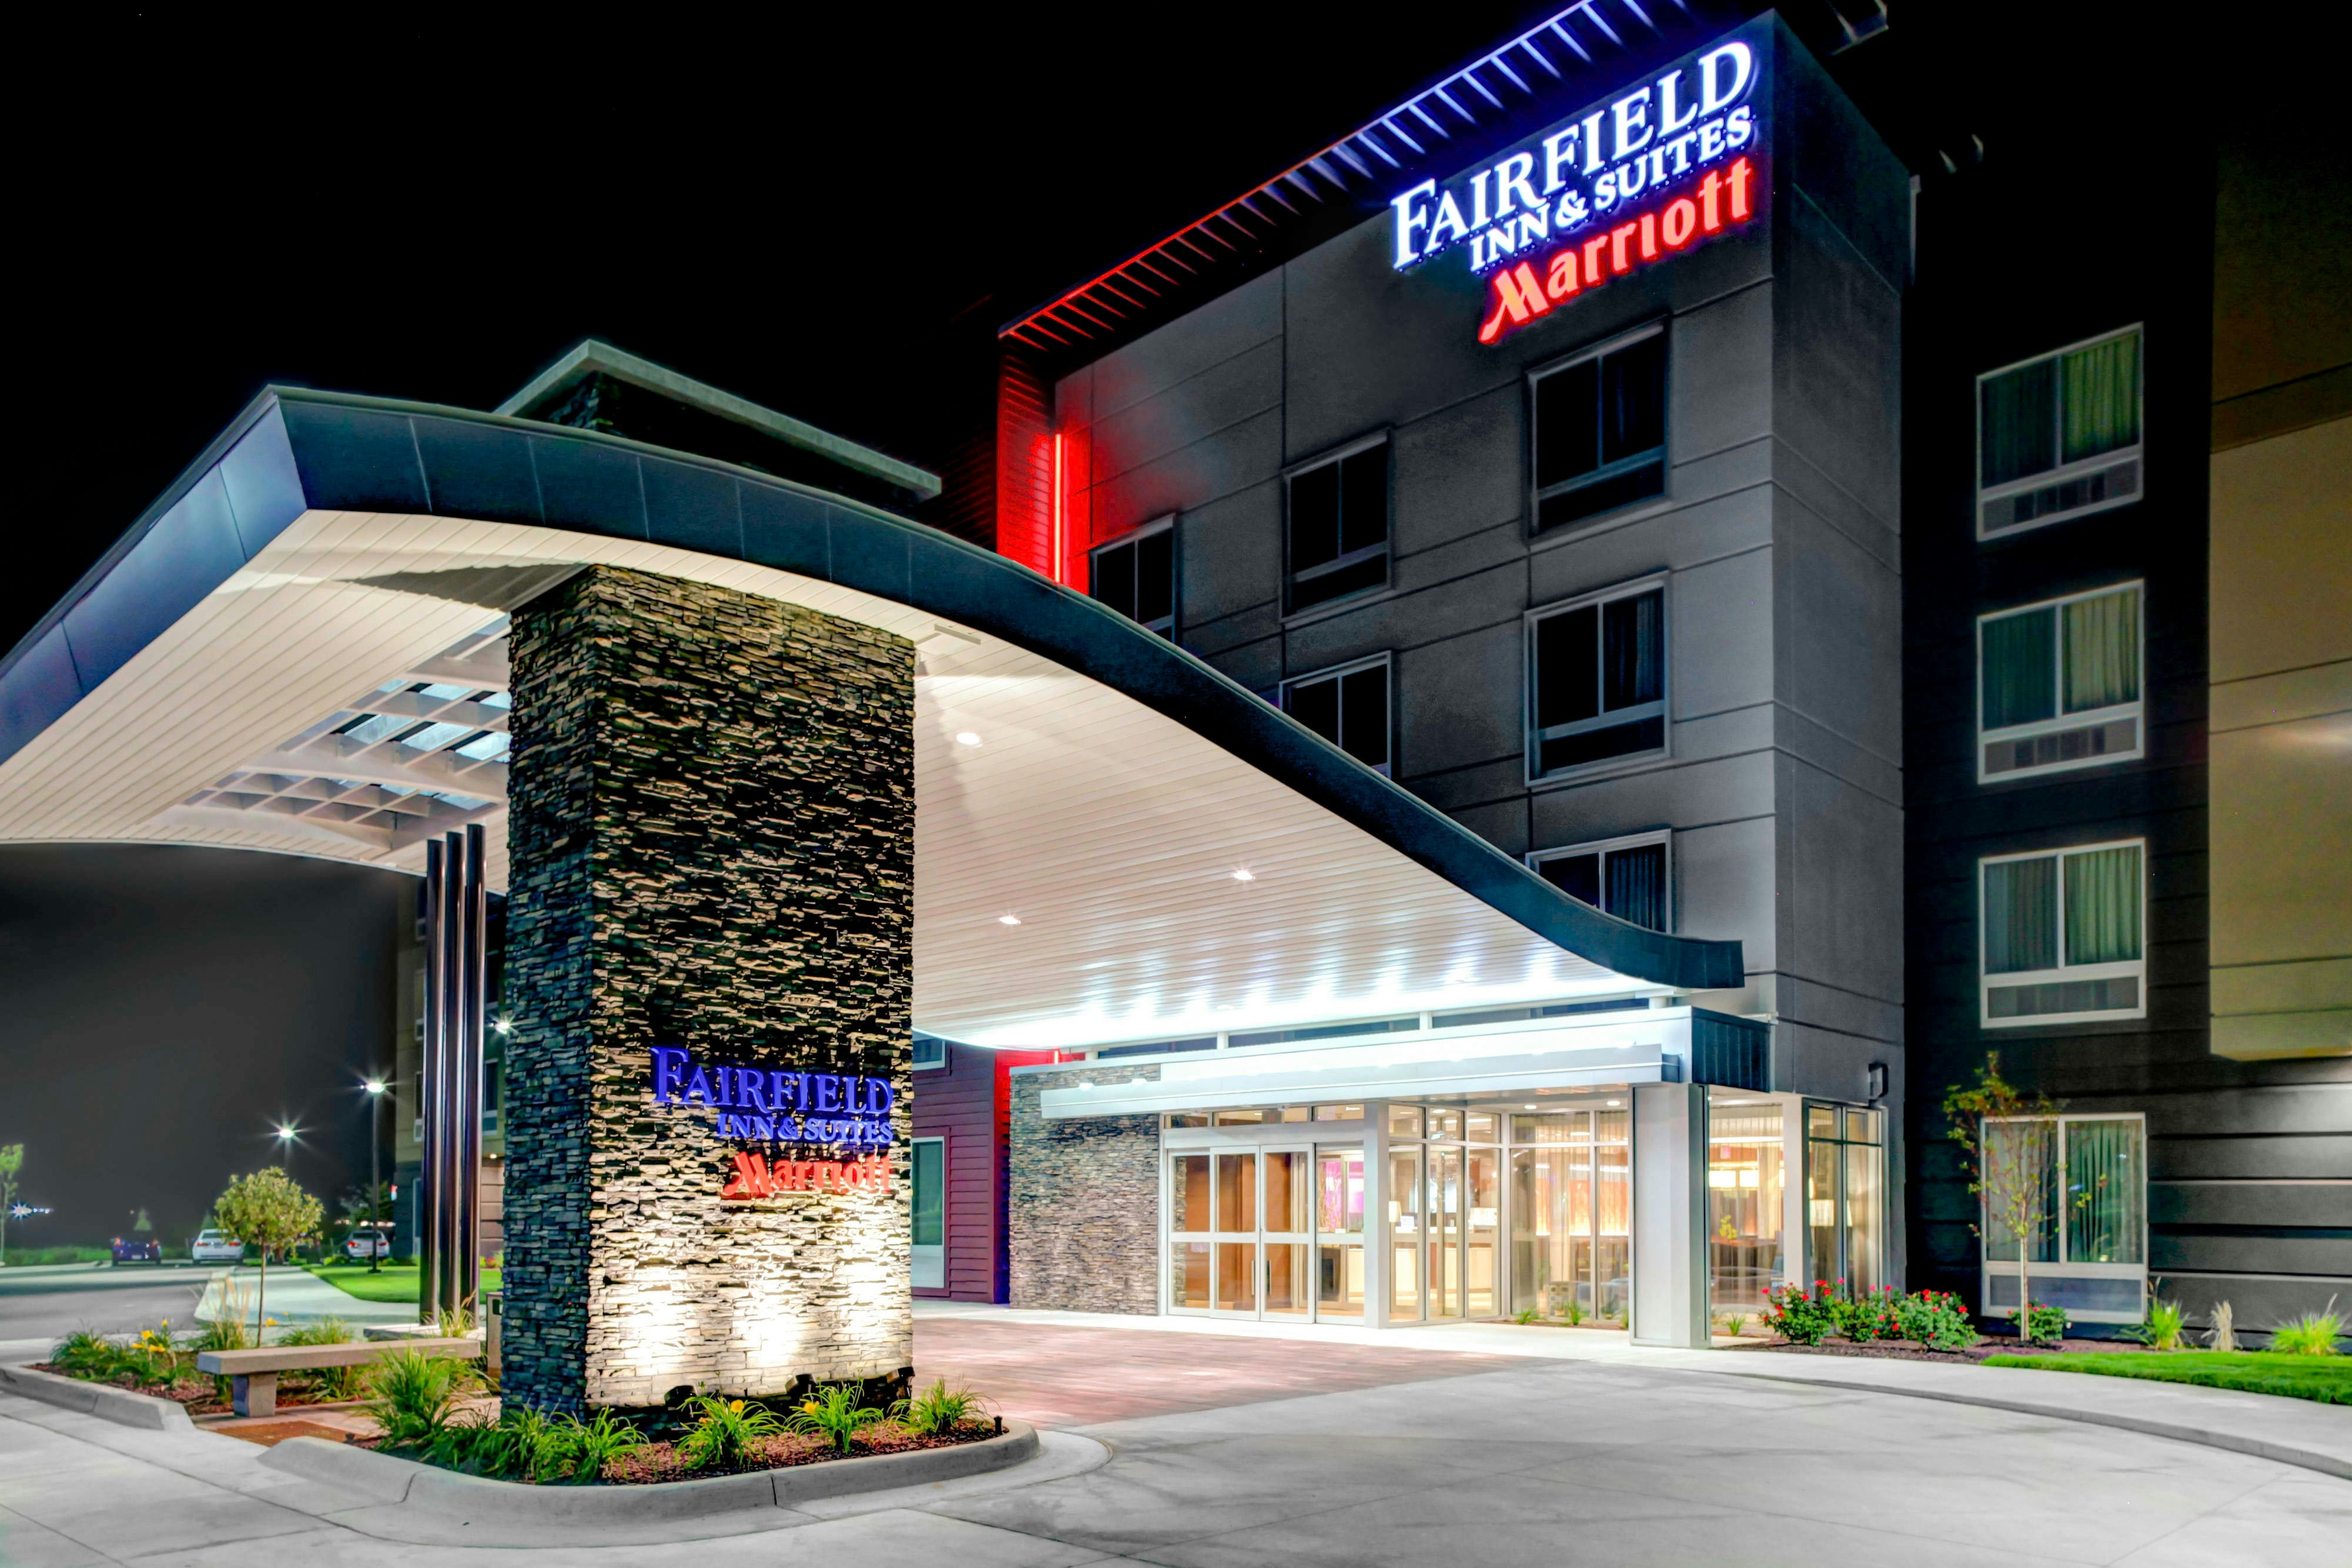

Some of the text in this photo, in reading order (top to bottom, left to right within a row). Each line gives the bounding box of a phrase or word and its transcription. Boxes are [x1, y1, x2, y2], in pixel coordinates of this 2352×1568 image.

[1390, 41, 1752, 270] FAIRFIELD
[1471, 105, 1754, 273] INN & SUITES
[1478, 157, 1751, 345] Marriott
[650, 1047, 894, 1115] FAIRFIELD
[716, 1113, 894, 1144] INN & SUITES
[721, 1151, 892, 1199] Marriott
